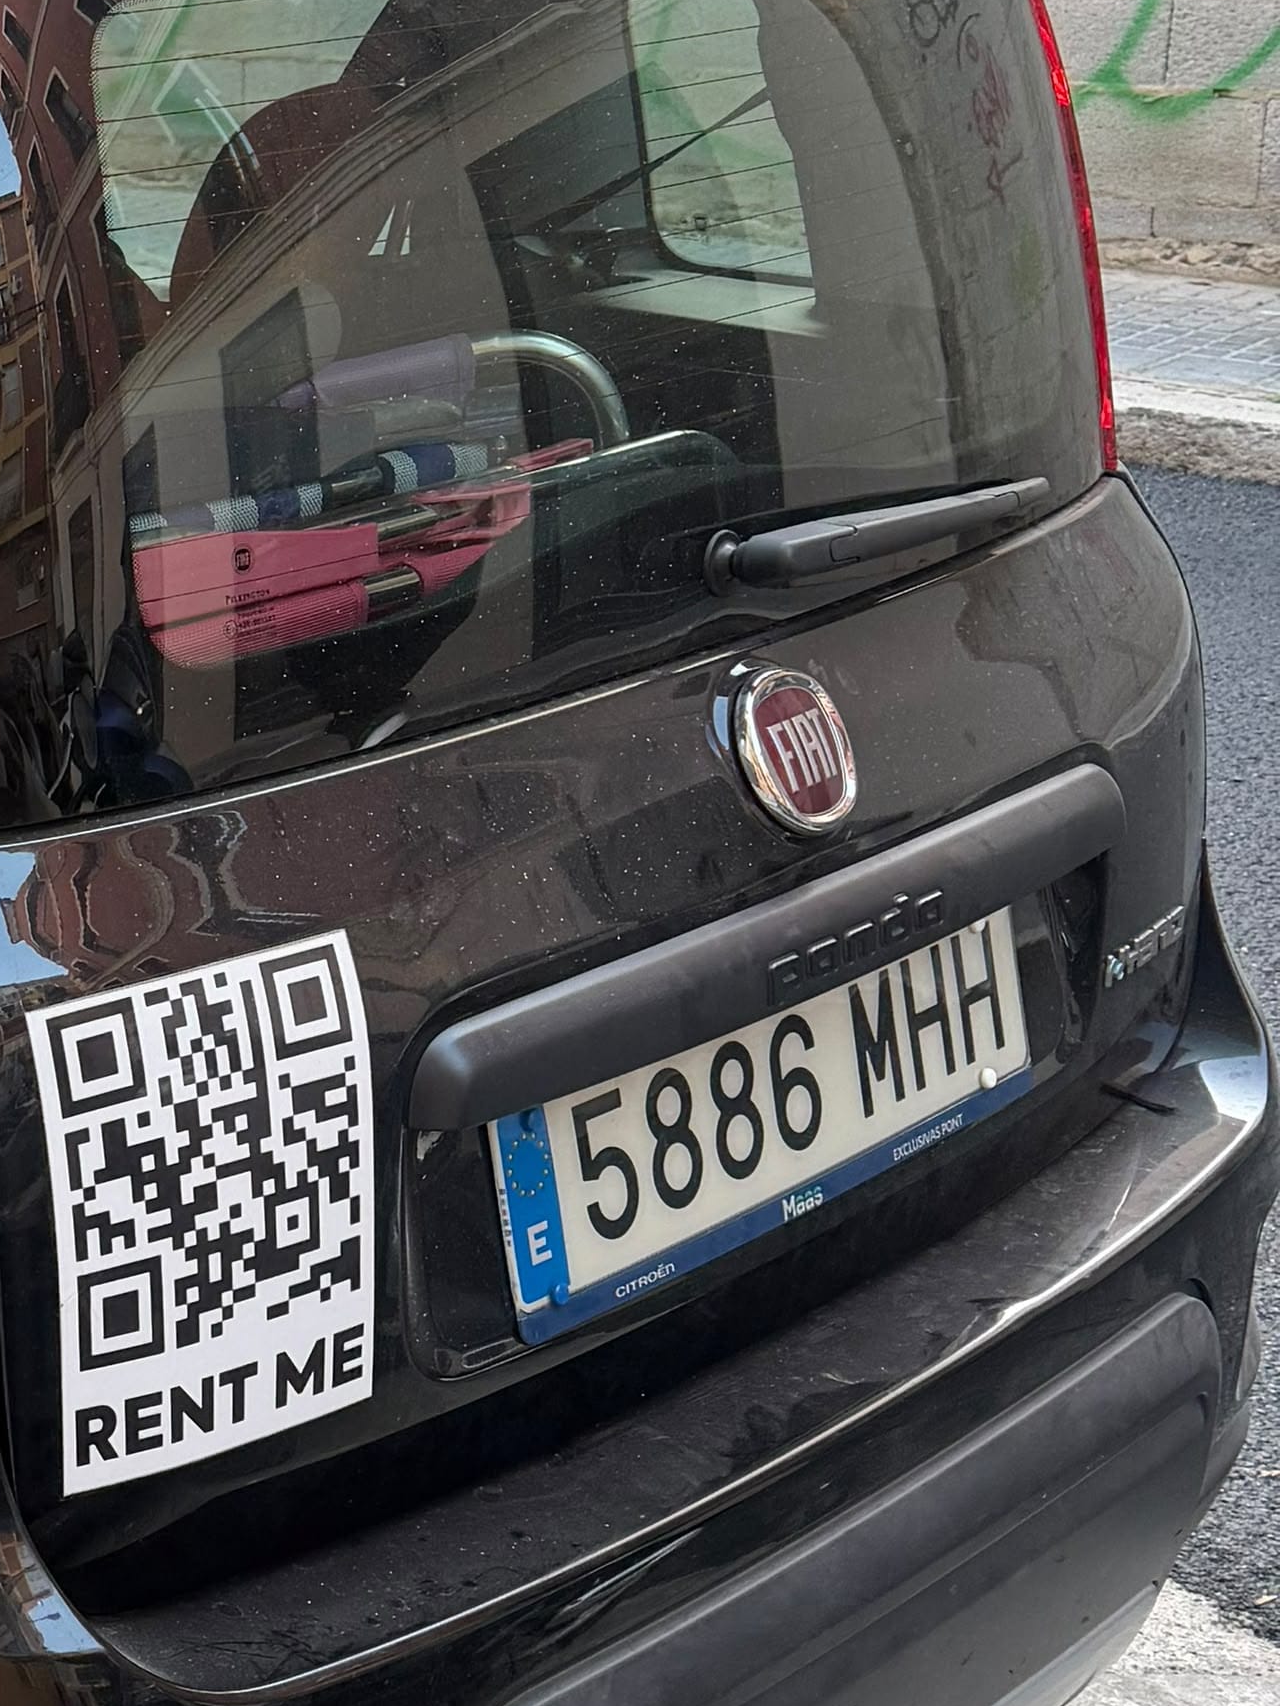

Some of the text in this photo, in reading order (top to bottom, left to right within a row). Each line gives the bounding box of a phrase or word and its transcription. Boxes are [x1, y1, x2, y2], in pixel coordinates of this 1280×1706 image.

[766, 708, 838, 793] FIAT
[571, 921, 1006, 1240] 5886 MHH
[782, 1186, 824, 1223] Maas
[892, 1128, 941, 1161] EXCLUSIVAS
[941, 1113, 964, 1136] PONT
[527, 1220, 552, 1266] E
[75, 1323, 365, 1468] RENT ME
